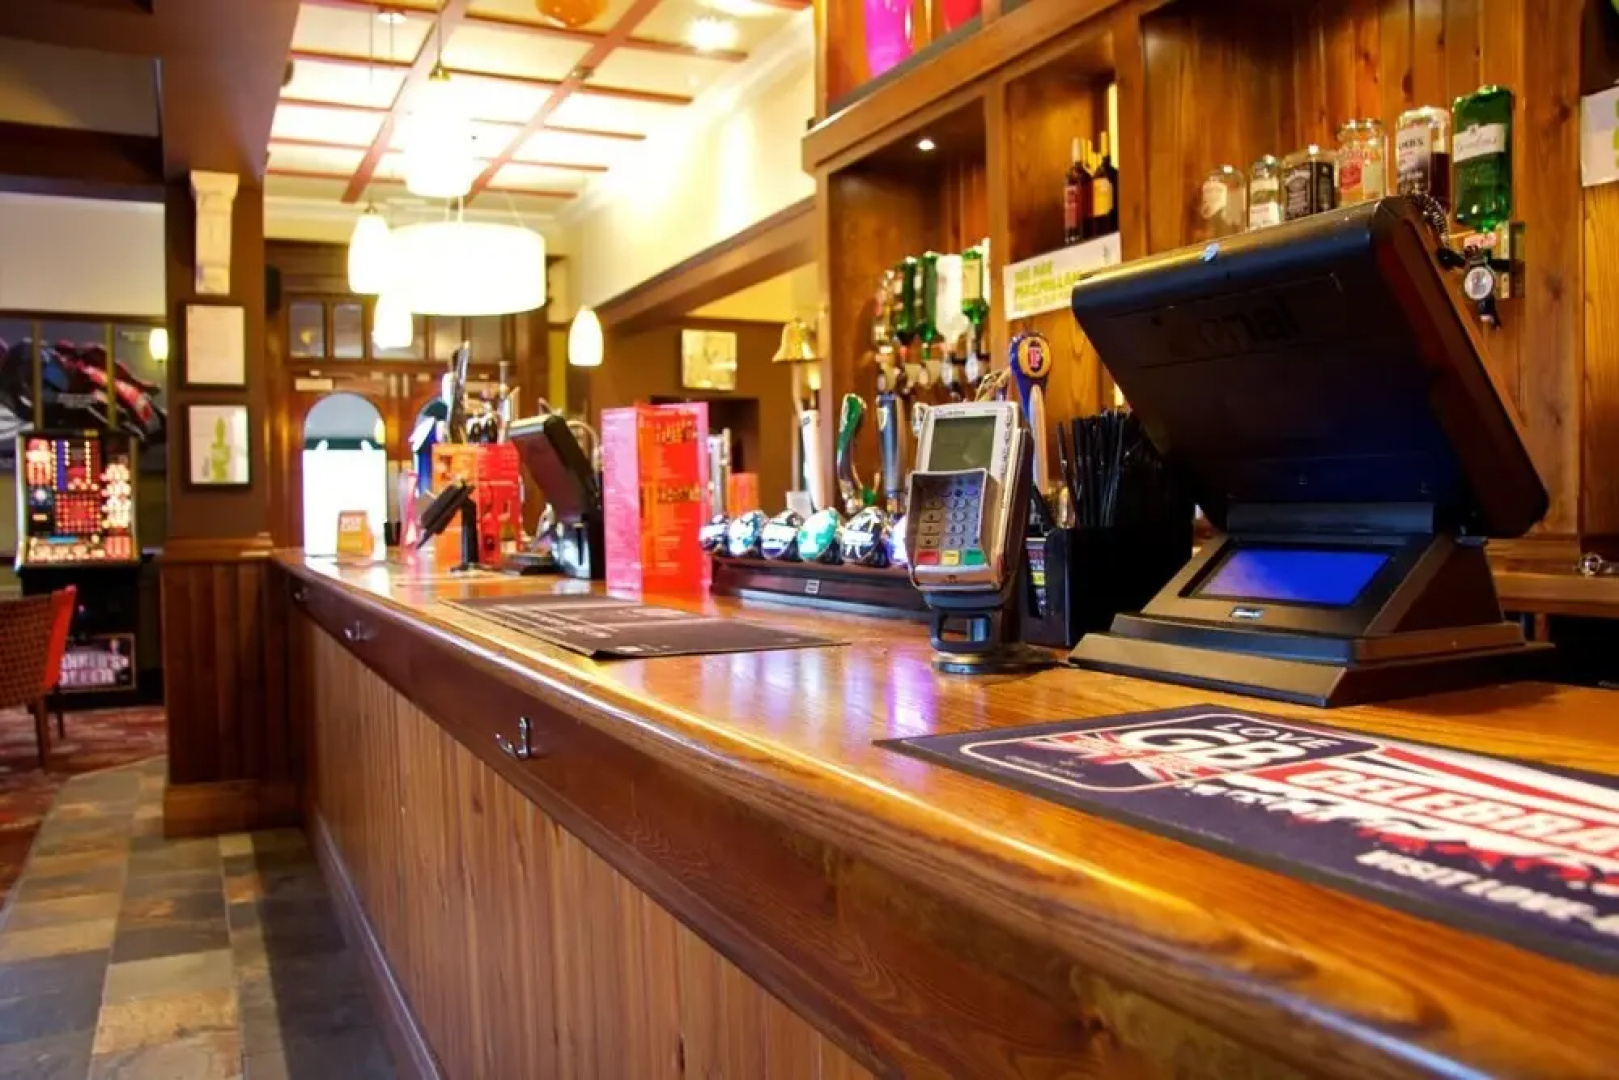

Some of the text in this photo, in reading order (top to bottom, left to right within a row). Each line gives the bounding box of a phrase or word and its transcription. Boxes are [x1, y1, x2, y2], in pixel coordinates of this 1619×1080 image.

[1119, 728, 1307, 770] GB
[1212, 722, 1343, 749] LOVE
[1356, 850, 1478, 887] VISIT
